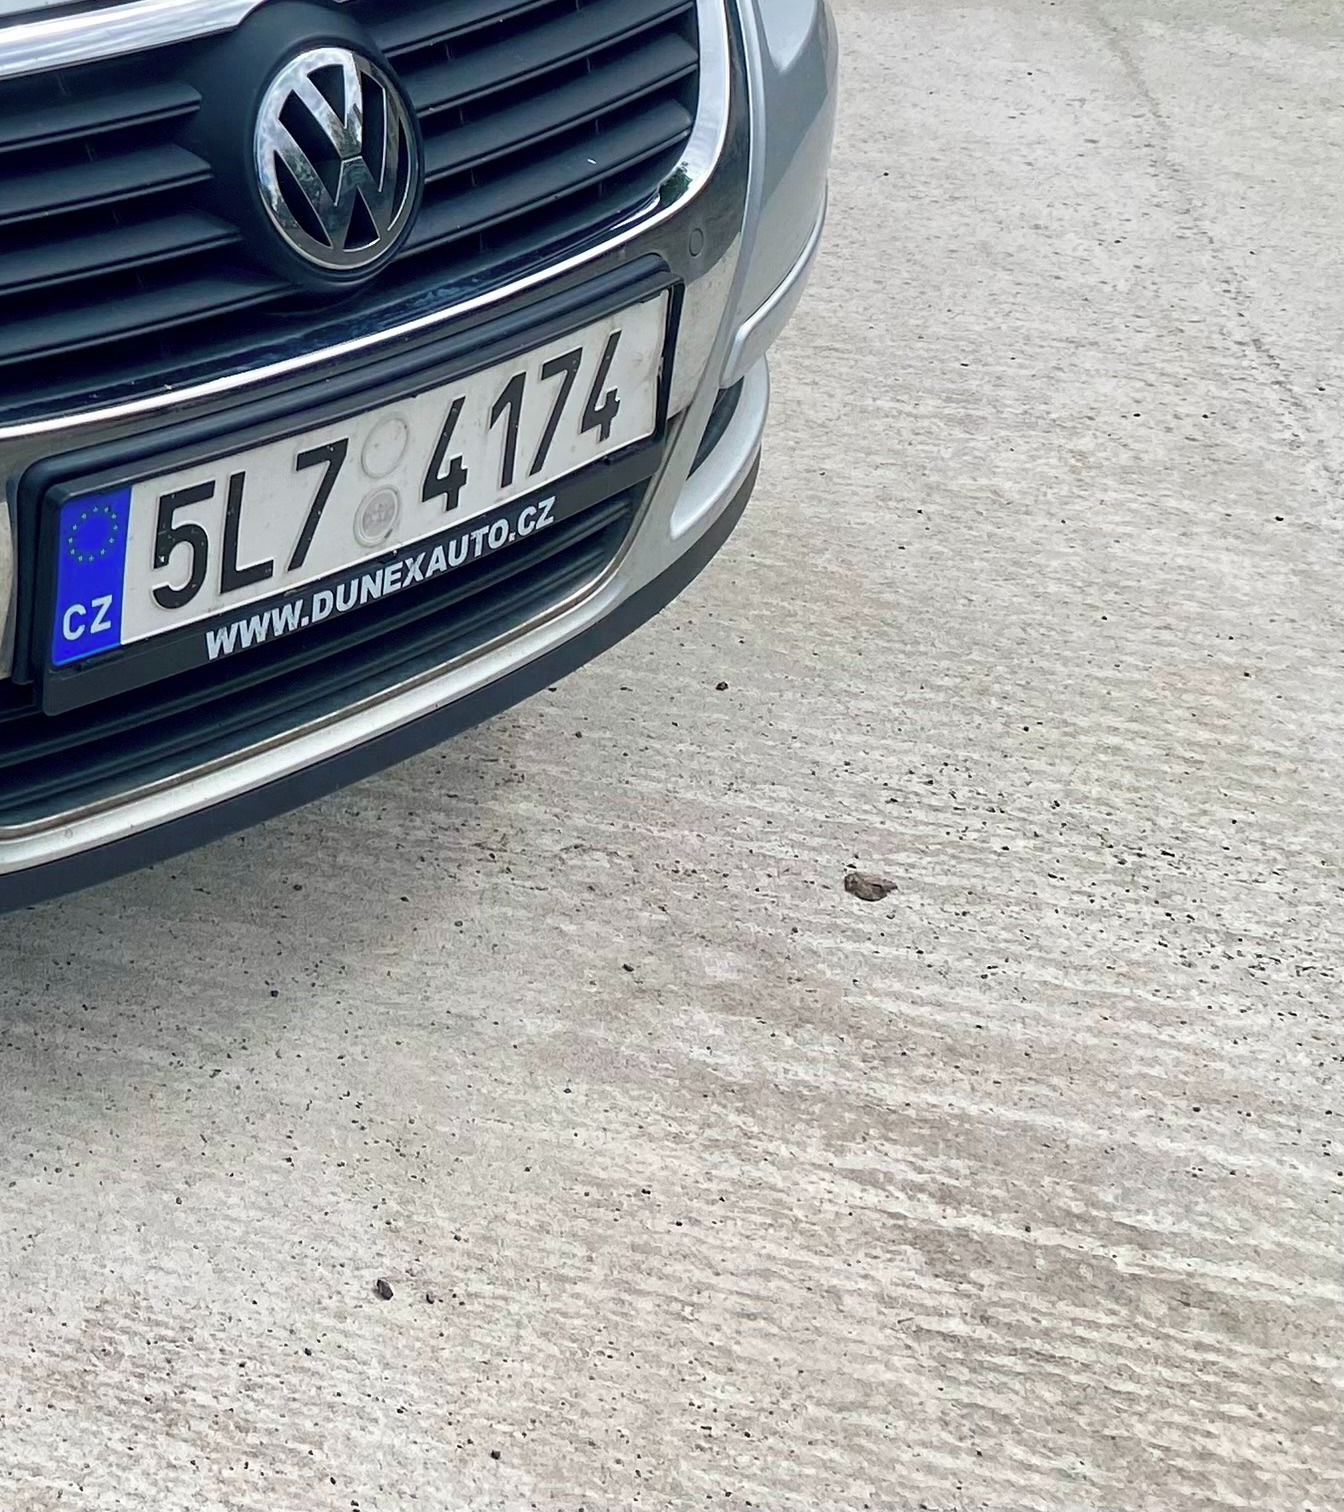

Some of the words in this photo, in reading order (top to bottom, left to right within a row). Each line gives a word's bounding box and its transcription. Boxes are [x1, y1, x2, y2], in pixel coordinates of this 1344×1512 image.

[151, 438, 349, 610] 5L7
[420, 330, 622, 513] 4174
[62, 594, 112, 642] CZ
[205, 495, 556, 661] WWW.DUNEXAUTO.CZ
